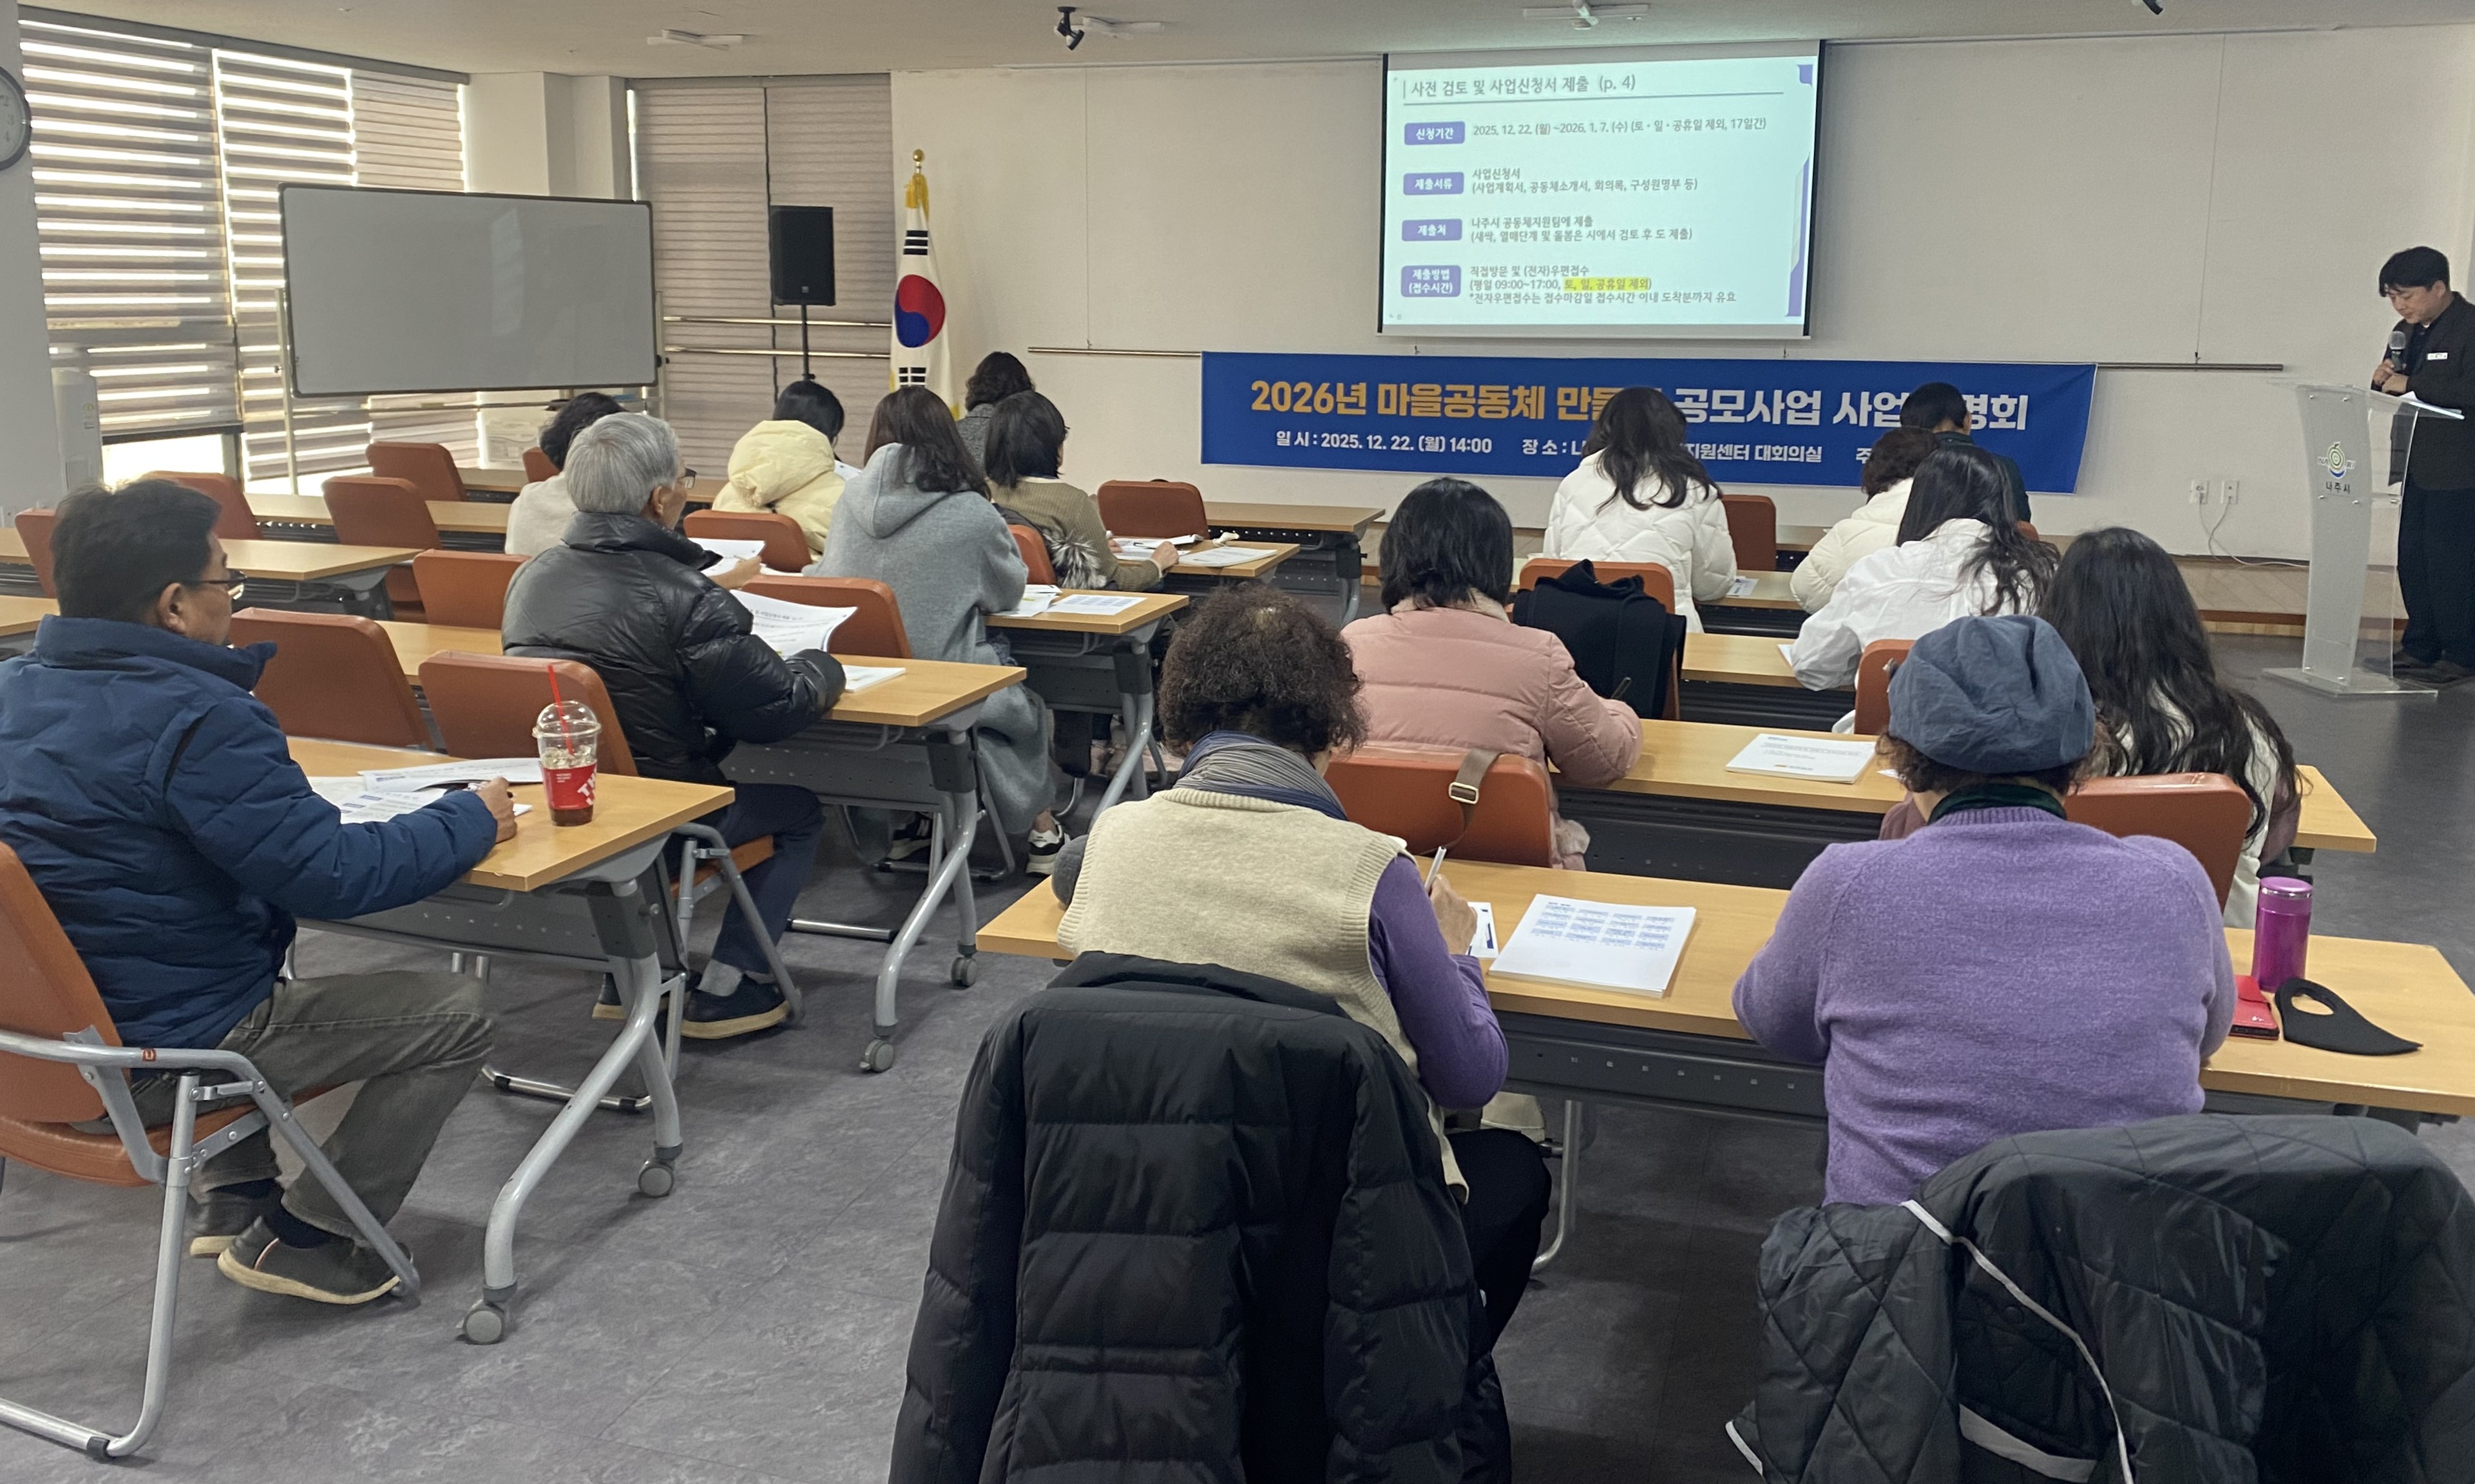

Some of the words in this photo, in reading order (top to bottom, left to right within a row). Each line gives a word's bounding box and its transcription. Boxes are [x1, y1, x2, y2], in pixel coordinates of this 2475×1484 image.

[1411, 81, 1437, 98] 사전
[1442, 80, 1468, 97] 검토
[1473, 79, 1486, 96] 및
[1489, 76, 1557, 94] 사업신청서
[1562, 75, 1590, 93] 제출
[1598, 74, 1617, 93] (p.
[1621, 73, 1637, 90] 4)
[1534, 123, 1551, 136] (월)
[1611, 121, 1629, 135] (수)
[1672, 118, 1703, 133] 공휴일
[1730, 117, 1766, 131] 17일간)
[1415, 128, 1455, 140] 신청기간
[1473, 168, 1521, 180] 사업신청서
[1415, 178, 1453, 191] 제출서류
[1472, 181, 1527, 195] (사업계획서,
[1529, 180, 1591, 193] 공동체소개서,
[1630, 178, 1681, 191] 구성원명부
[1683, 178, 1699, 191] 등)
[1471, 218, 1500, 229] 나주시
[1503, 216, 1571, 229] 공동체지원팀에
[1573, 215, 1594, 227] 제출
[1417, 224, 1448, 237] 제출처
[1541, 229, 1551, 242] 및
[1585, 228, 1616, 241] 시에서
[1619, 229, 1640, 241] 검토
[1668, 227, 1694, 241] 제출)
[1411, 268, 1451, 282] 제출방법
[1470, 265, 1509, 278] 직접방문
[1511, 265, 1521, 278] 및
[1408, 282, 1453, 295] (접수시간)
[1596, 278, 1627, 290] 공휴일
[1629, 277, 1652, 290] 제외)
[1543, 292, 1594, 304] 접수마감일
[1596, 292, 1636, 303] 접수시간
[1639, 290, 1659, 303] 이내
[1715, 290, 1737, 303] 유효
[1252, 380, 1366, 415] 2026년
[1377, 383, 1545, 419] 마을공동체
[1674, 388, 1822, 426] 공모사업
[1832, 391, 2029, 430] 사업명회
[1321, 433, 1363, 450] 2025.
[1366, 435, 1387, 450] 12.
[1390, 435, 1414, 451] 22.
[1419, 435, 1446, 453] (월)
[1449, 437, 1492, 453] 14:00
[1754, 444, 1822, 462] 대회의실
